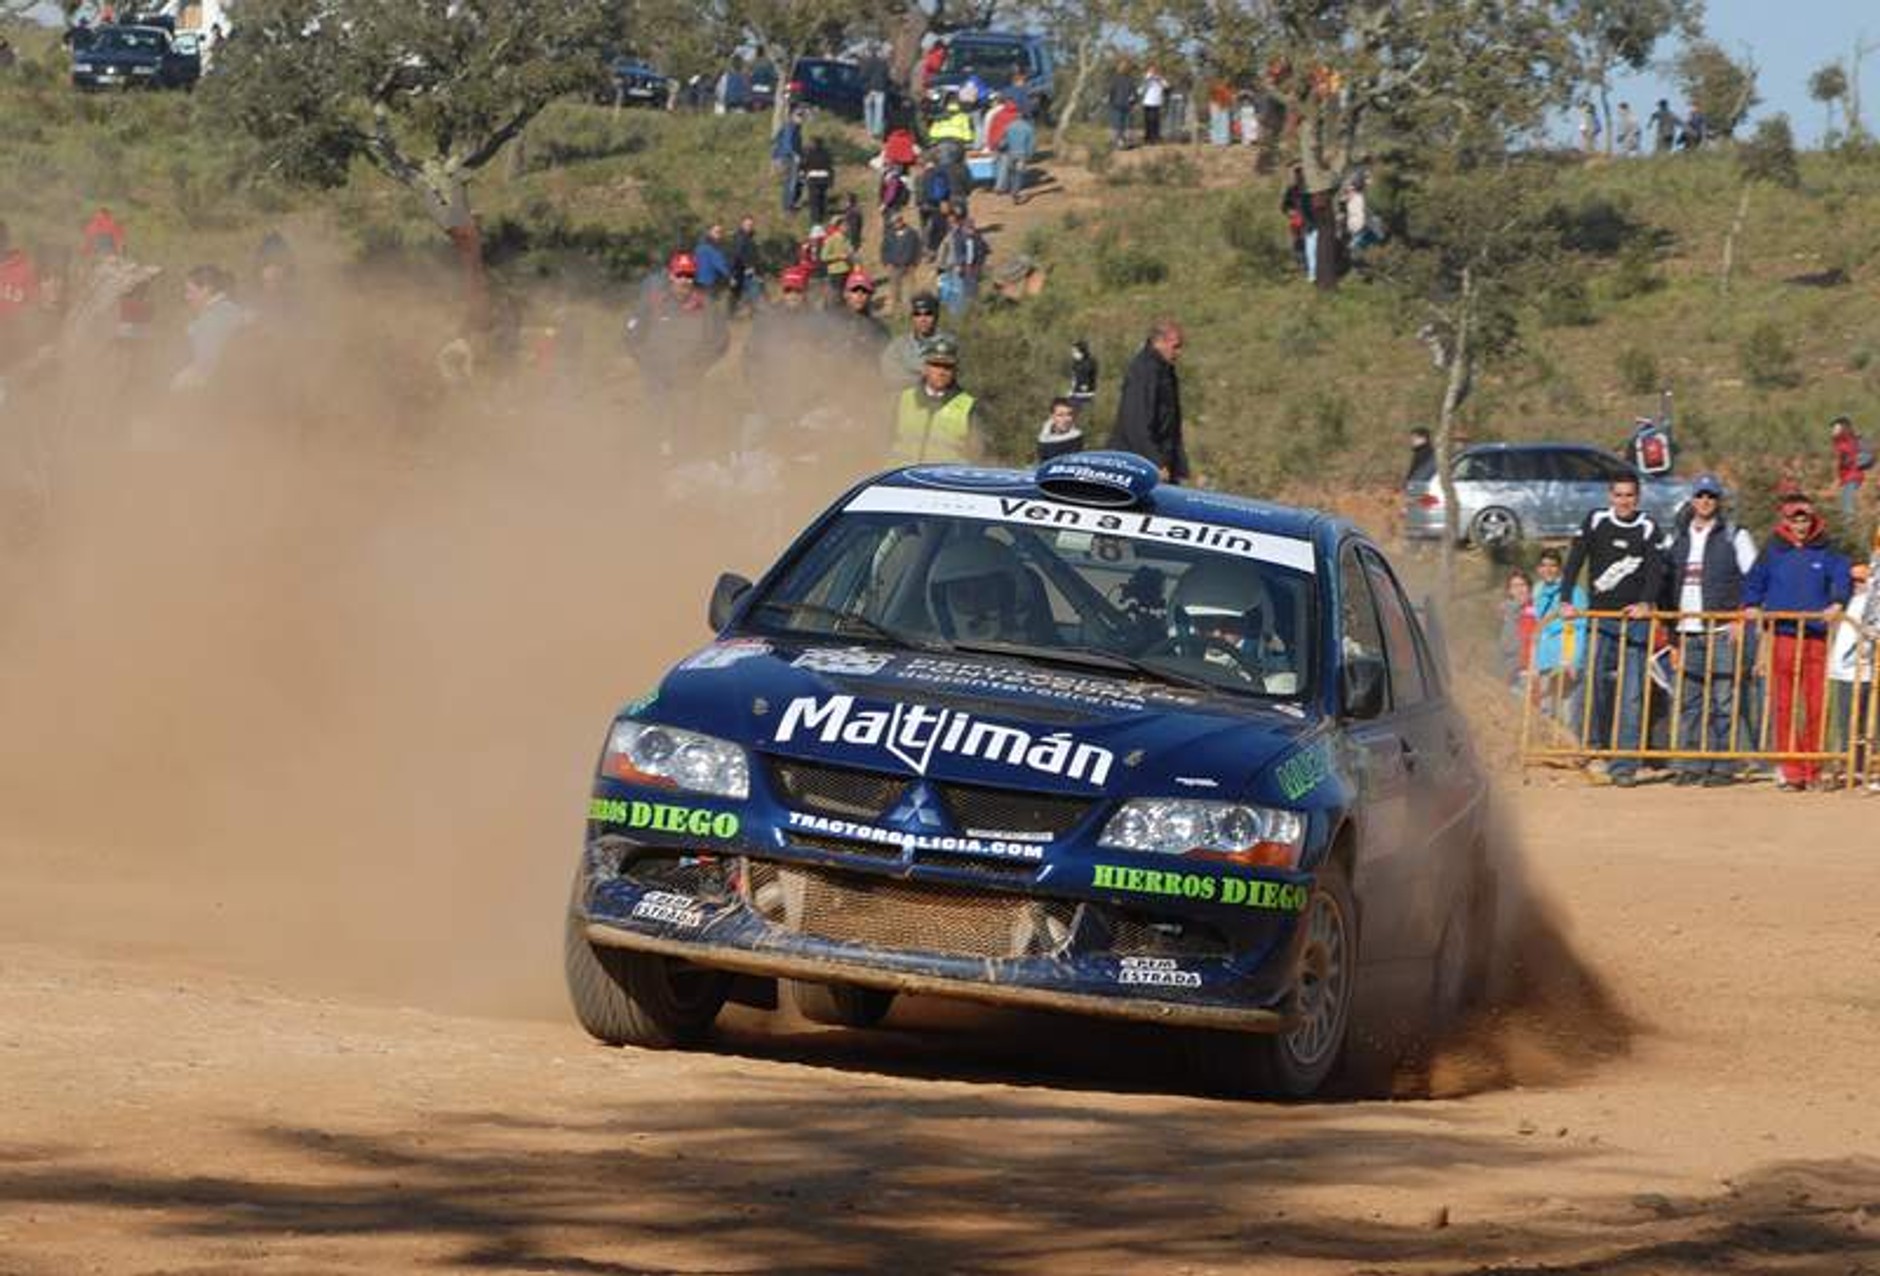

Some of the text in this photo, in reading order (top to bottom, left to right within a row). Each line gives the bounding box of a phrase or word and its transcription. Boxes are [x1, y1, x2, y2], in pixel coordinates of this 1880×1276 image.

[999, 498, 1081, 524] Ven
[1097, 513, 1123, 530] a
[1138, 517, 1255, 551] Lalín
[774, 695, 1114, 786] Matimán
[629, 801, 740, 839] DIEGO
[788, 811, 1044, 859] TRACTORGALICIA.COM
[1092, 864, 1309, 908] HIERROS DIEGO
[1121, 971, 1199, 985] ESTRADA
